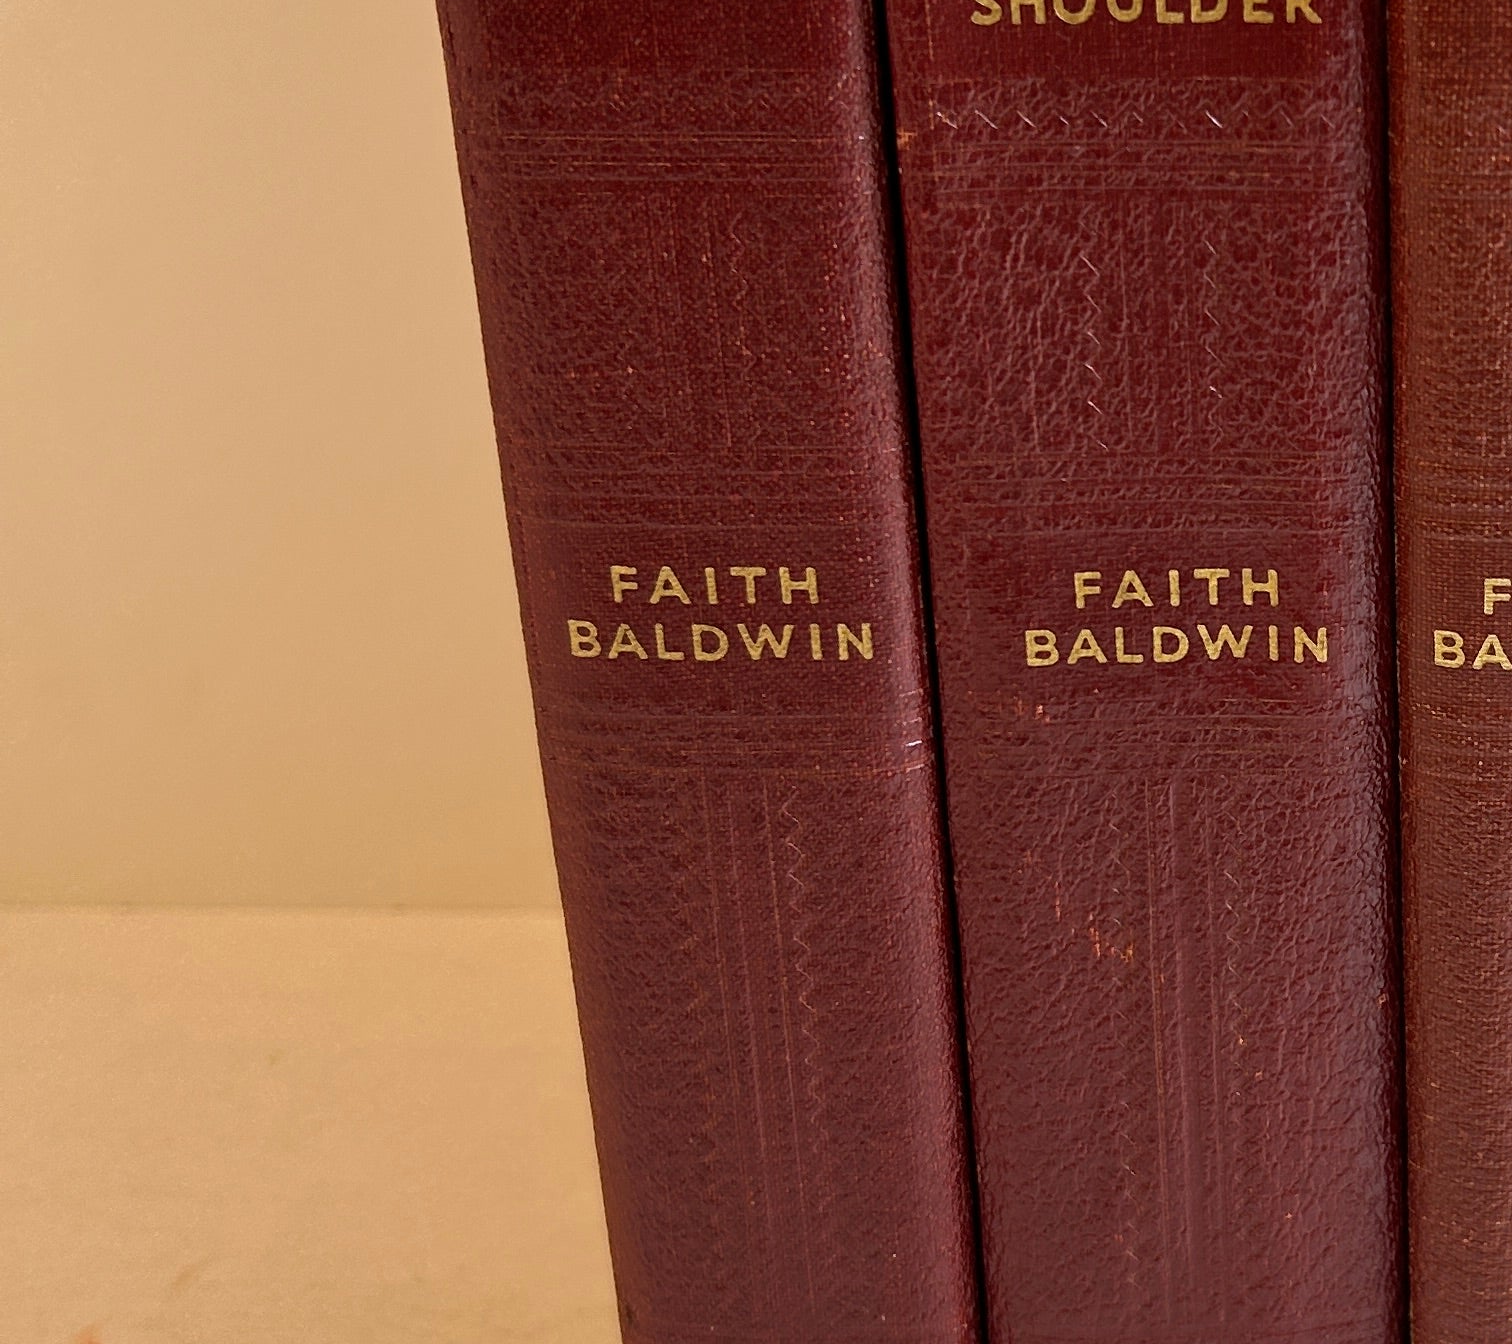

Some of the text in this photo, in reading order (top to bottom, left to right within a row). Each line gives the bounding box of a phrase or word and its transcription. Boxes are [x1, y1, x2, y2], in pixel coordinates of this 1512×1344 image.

[610, 565, 820, 605] FAITH
[1074, 568, 1280, 609] FAITH
[567, 619, 875, 662] BALDWIN
[1025, 625, 1329, 668] BALDWIN
